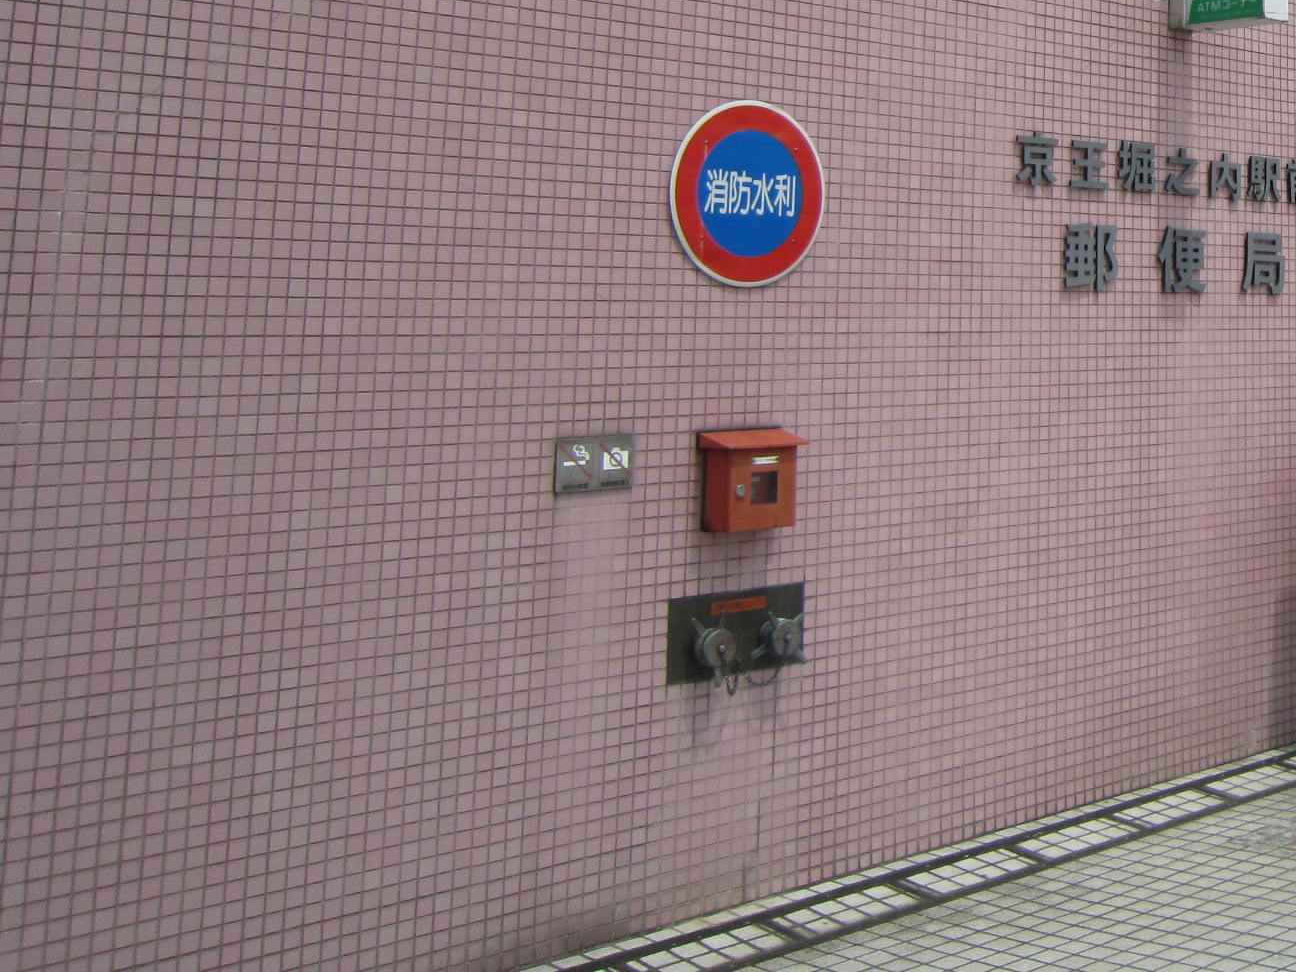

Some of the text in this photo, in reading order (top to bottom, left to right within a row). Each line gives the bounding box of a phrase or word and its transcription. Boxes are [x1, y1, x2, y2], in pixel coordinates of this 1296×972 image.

[704, 168, 796, 218] 消防水利
[1063, 221, 1286, 296] 郵便局
